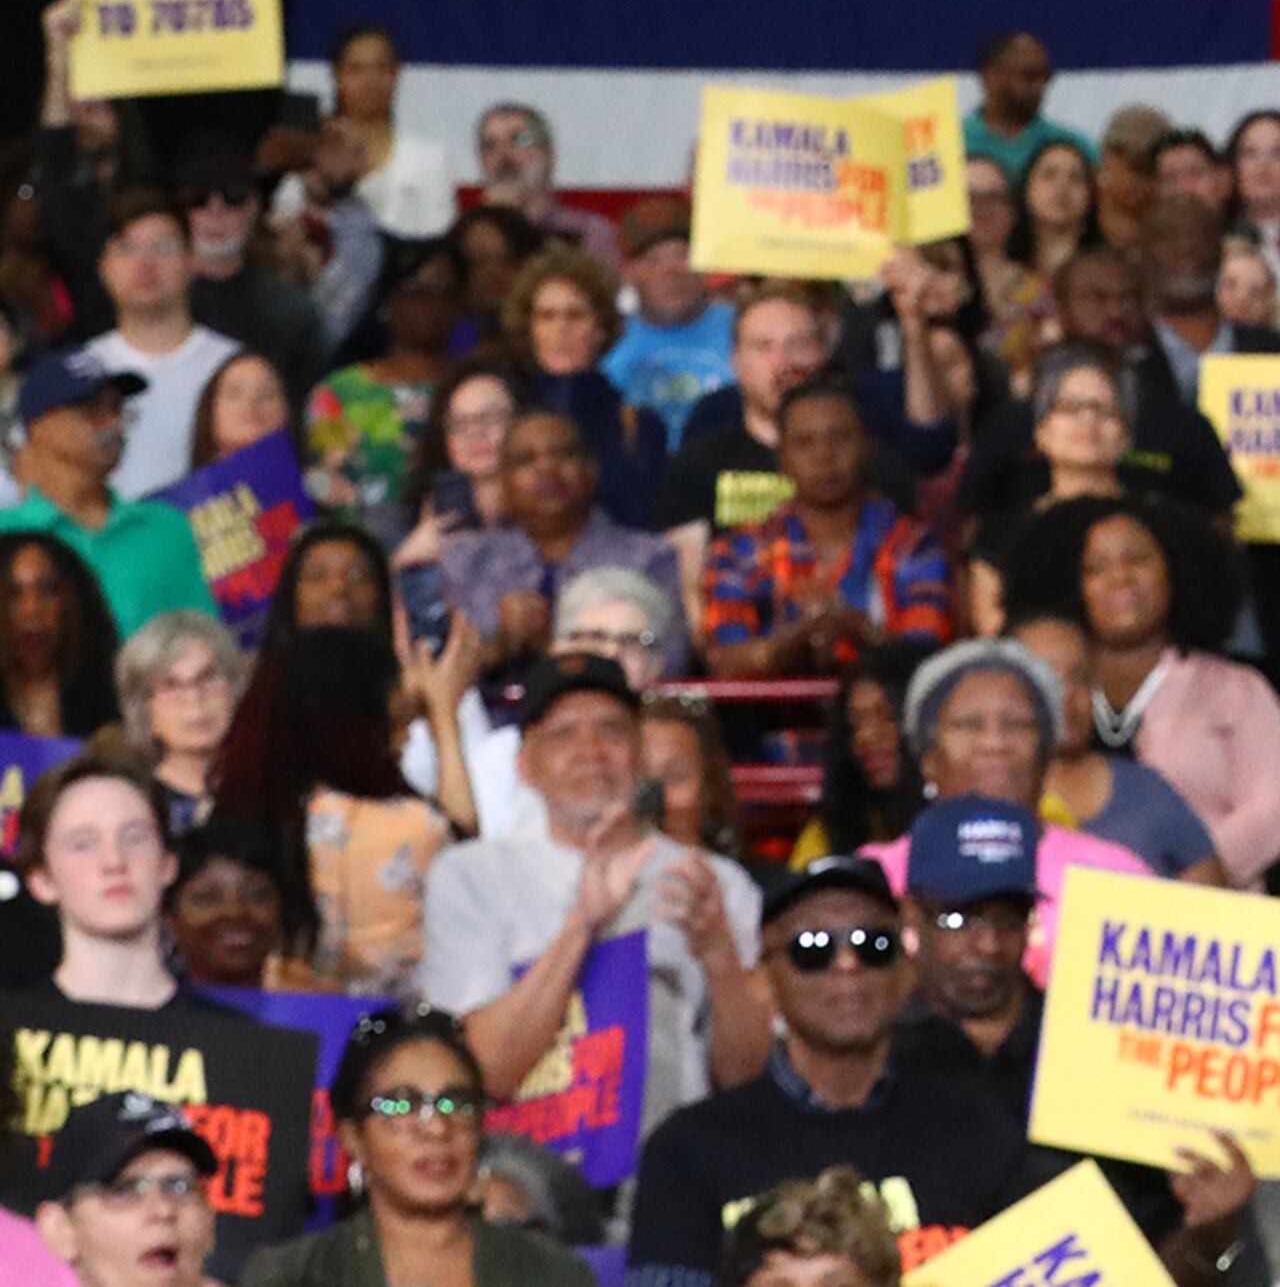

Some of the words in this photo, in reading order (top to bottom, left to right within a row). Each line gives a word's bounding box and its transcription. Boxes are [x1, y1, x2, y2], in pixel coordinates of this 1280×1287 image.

[98, 1, 137, 38] TO
[730, 120, 850, 156] KAMALA
[726, 157, 837, 194] HARRIS
[836, 161, 888, 196] FOR
[1098, 918, 1279, 997] KAMALA
[1090, 976, 1252, 1047] HARRIS
[13, 1027, 208, 1105] KAMALA
[1117, 1031, 1164, 1069] THE
